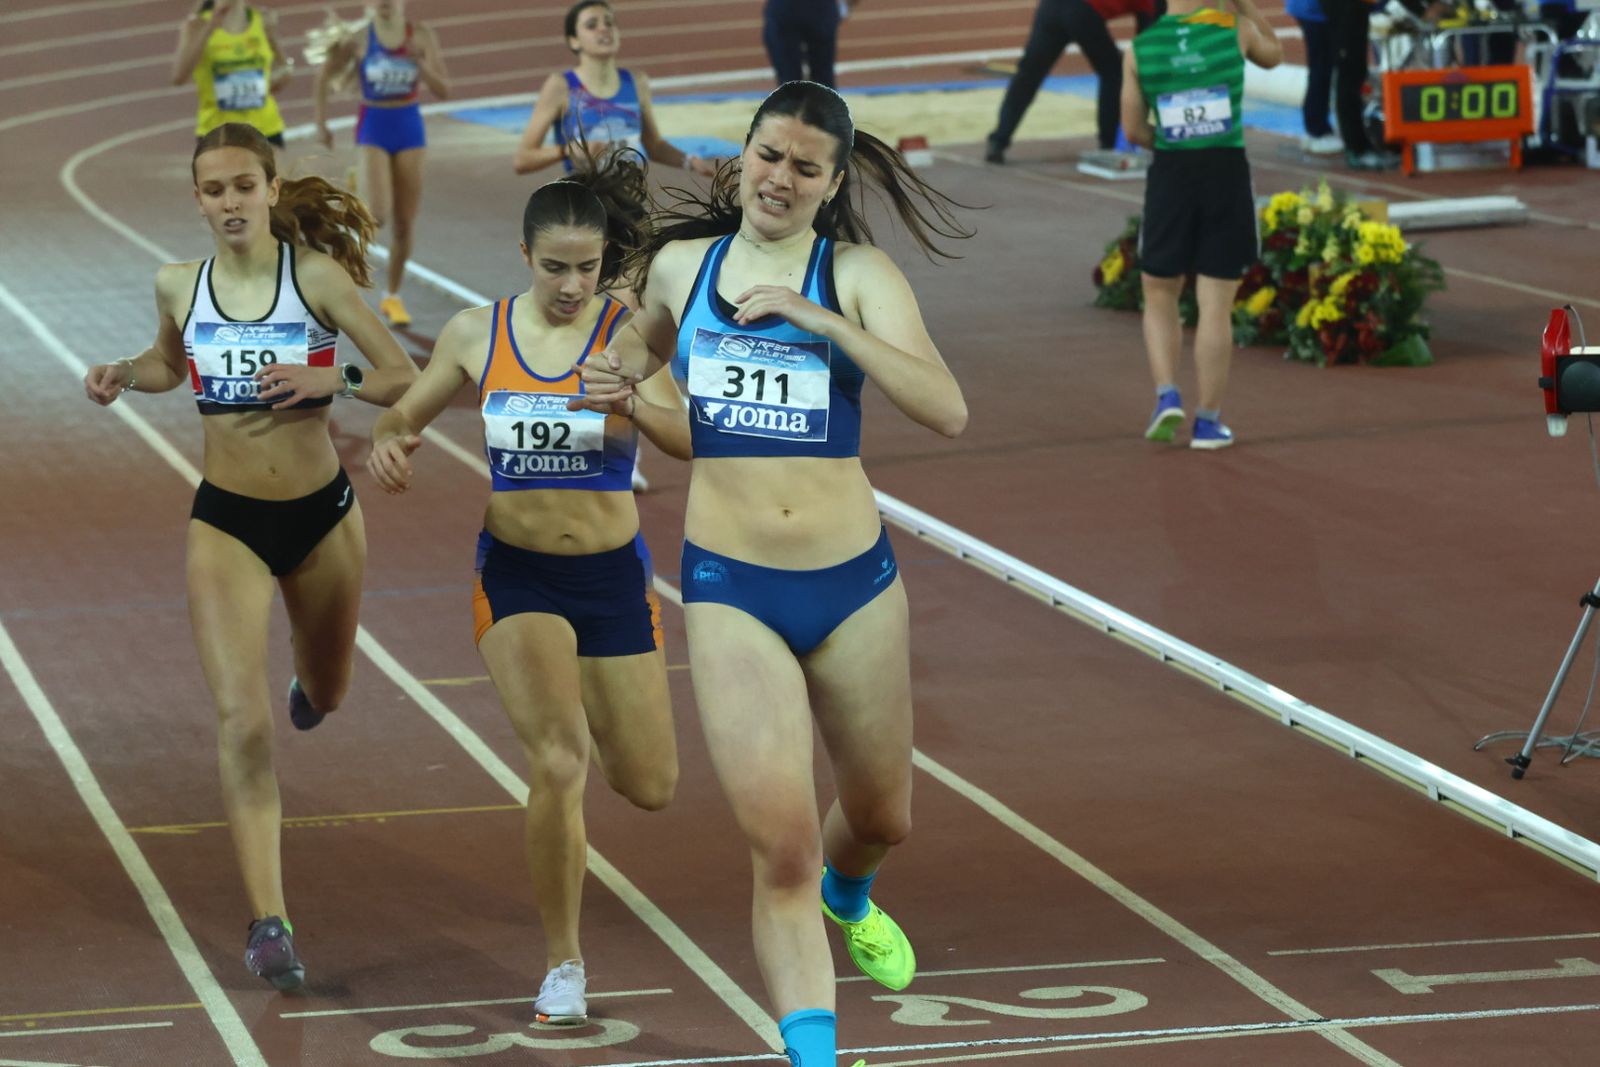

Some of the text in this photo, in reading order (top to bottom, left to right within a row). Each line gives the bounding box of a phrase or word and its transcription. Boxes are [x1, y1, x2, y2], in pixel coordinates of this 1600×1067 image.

[1183, 106, 1207, 124] 82
[1421, 83, 1516, 121] 0:00
[722, 365, 789, 405] 311
[510, 421, 572, 451] 192
[1369, 957, 1600, 995] 1
[872, 984, 1149, 1028] 2
[369, 1018, 641, 1058] 3
